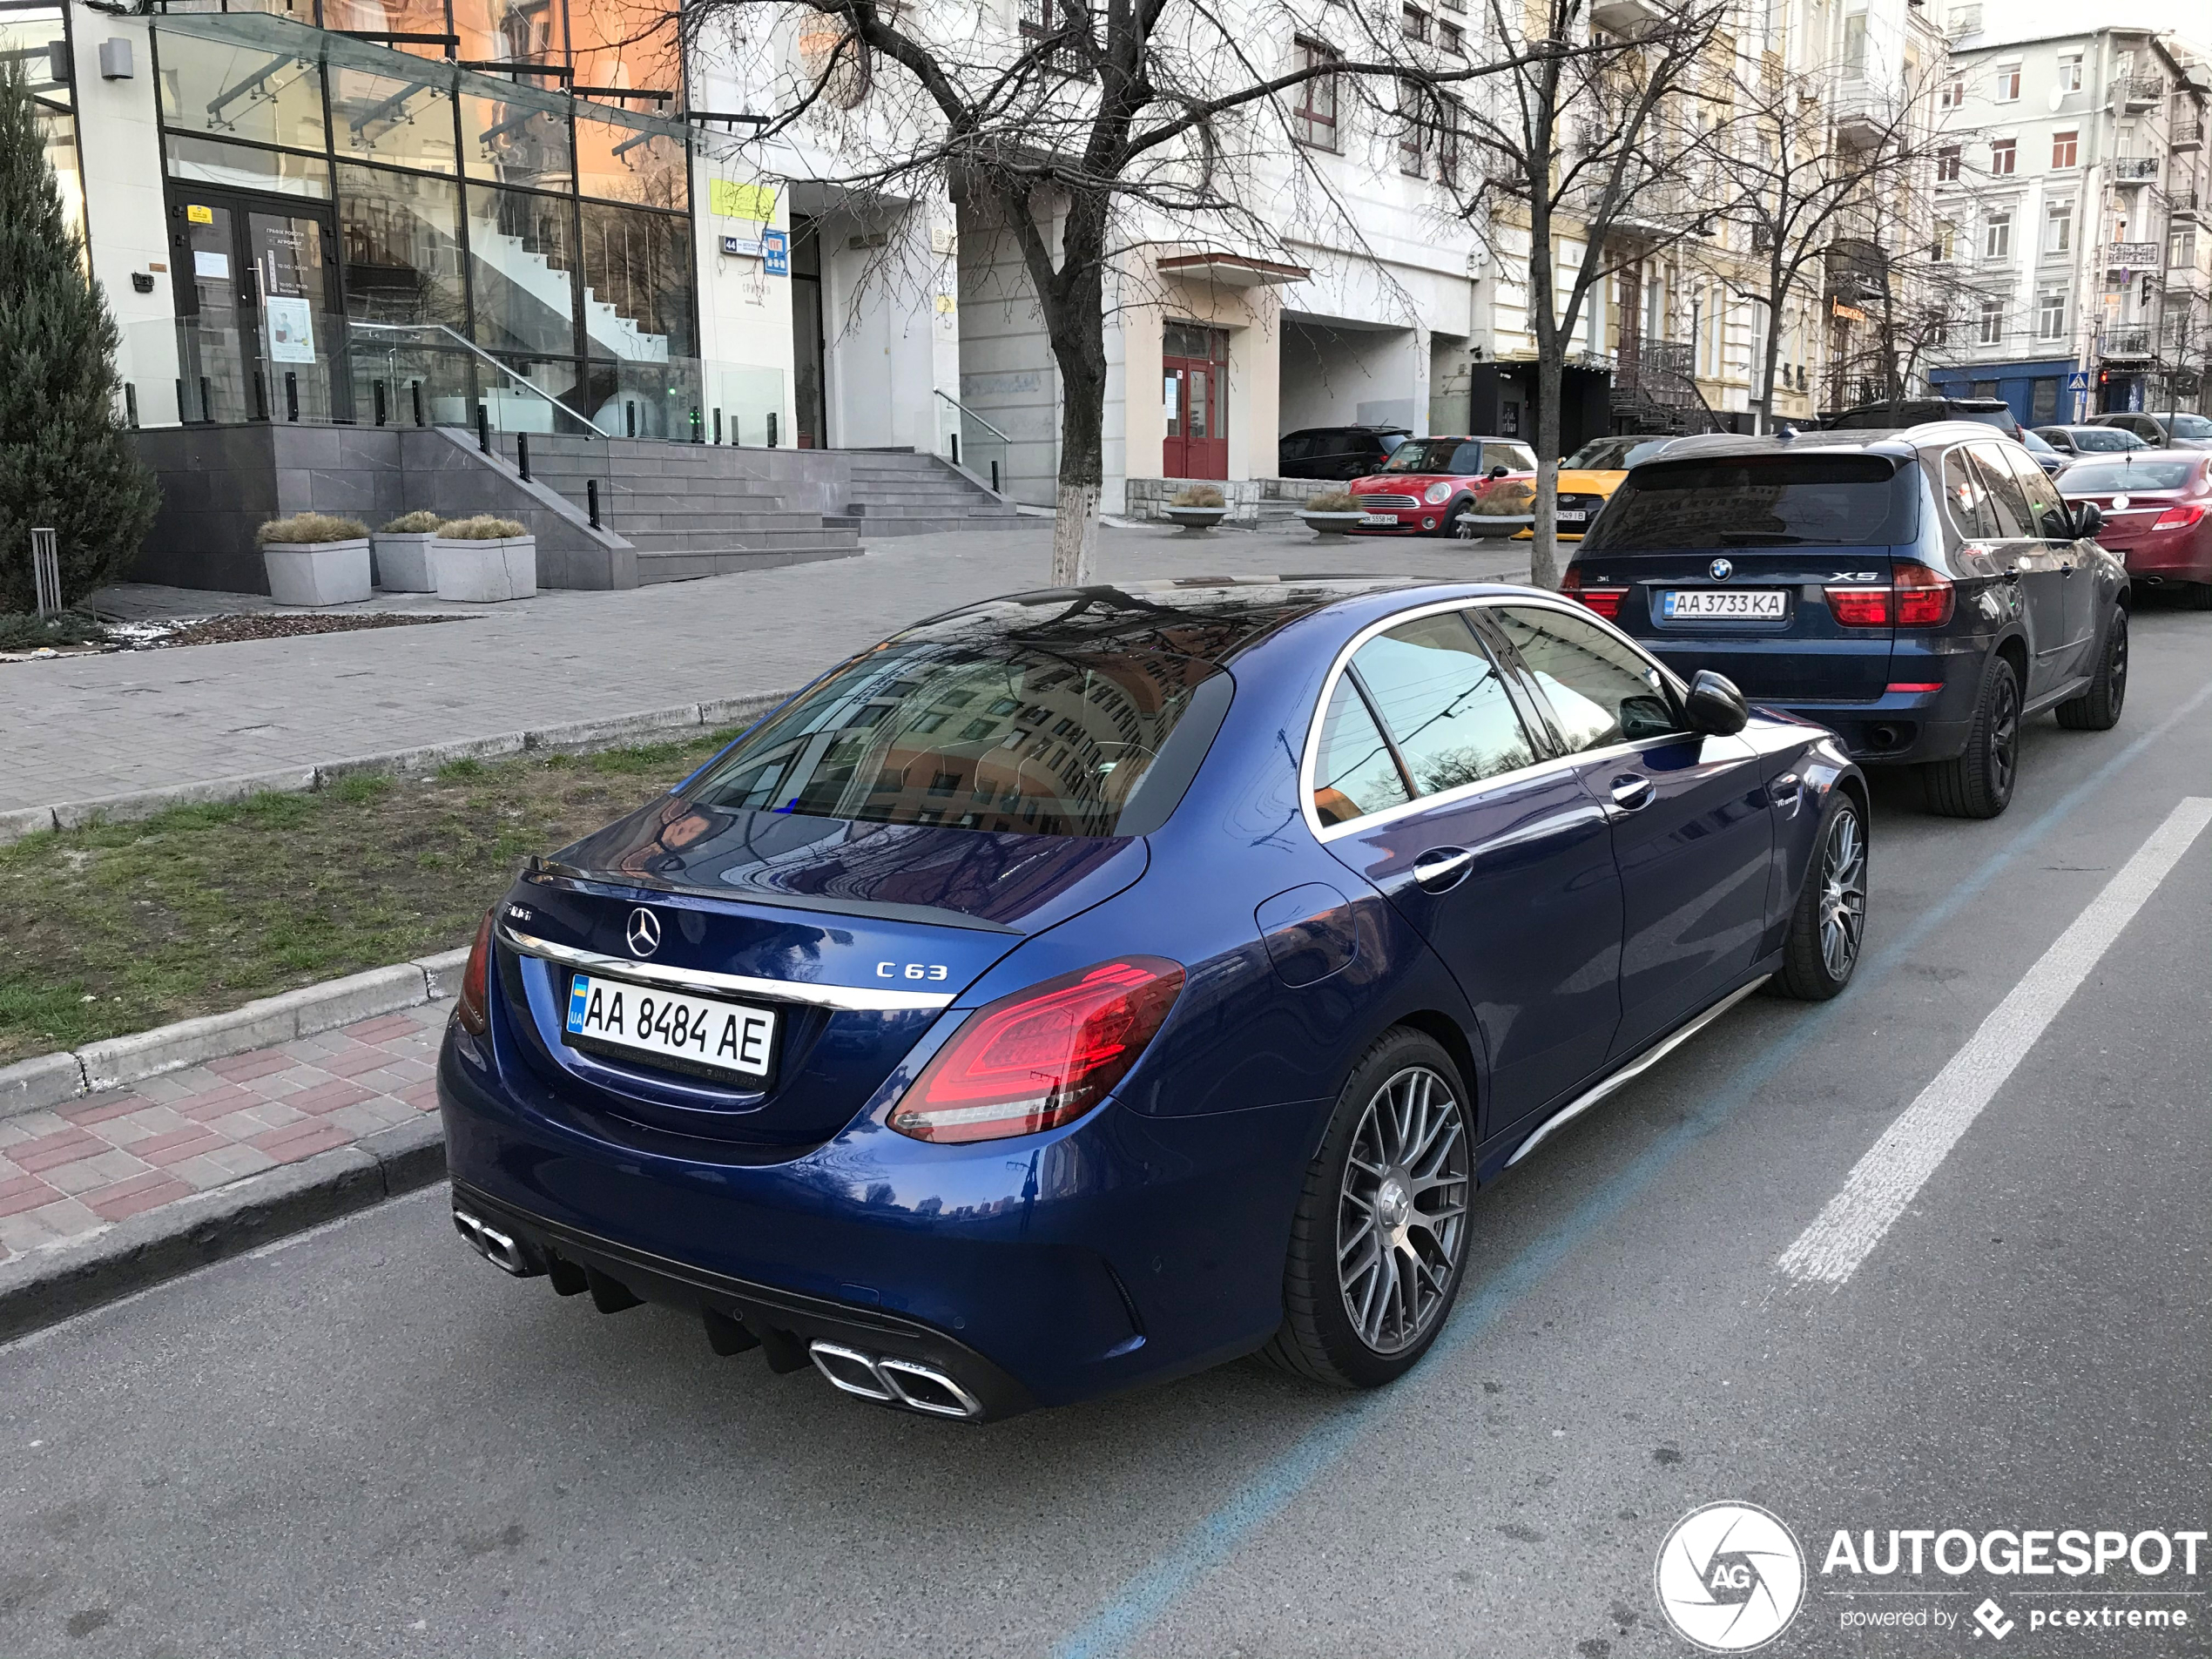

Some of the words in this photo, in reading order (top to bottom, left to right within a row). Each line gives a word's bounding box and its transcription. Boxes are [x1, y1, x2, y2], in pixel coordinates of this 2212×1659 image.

[726, 240, 736, 249] 44
[770, 239, 781, 250] ПГ
[1829, 571, 1878, 582] X5
[1676, 595, 1701, 612] AA
[1704, 595, 1749, 612] 3733
[1752, 595, 1780, 613] KA
[876, 961, 896, 978] C
[904, 963, 948, 981] 63
[570, 1010, 583, 1026] UA
[584, 987, 624, 1035] AA
[637, 997, 709, 1053] 8484
[717, 1014, 766, 1066] AE
